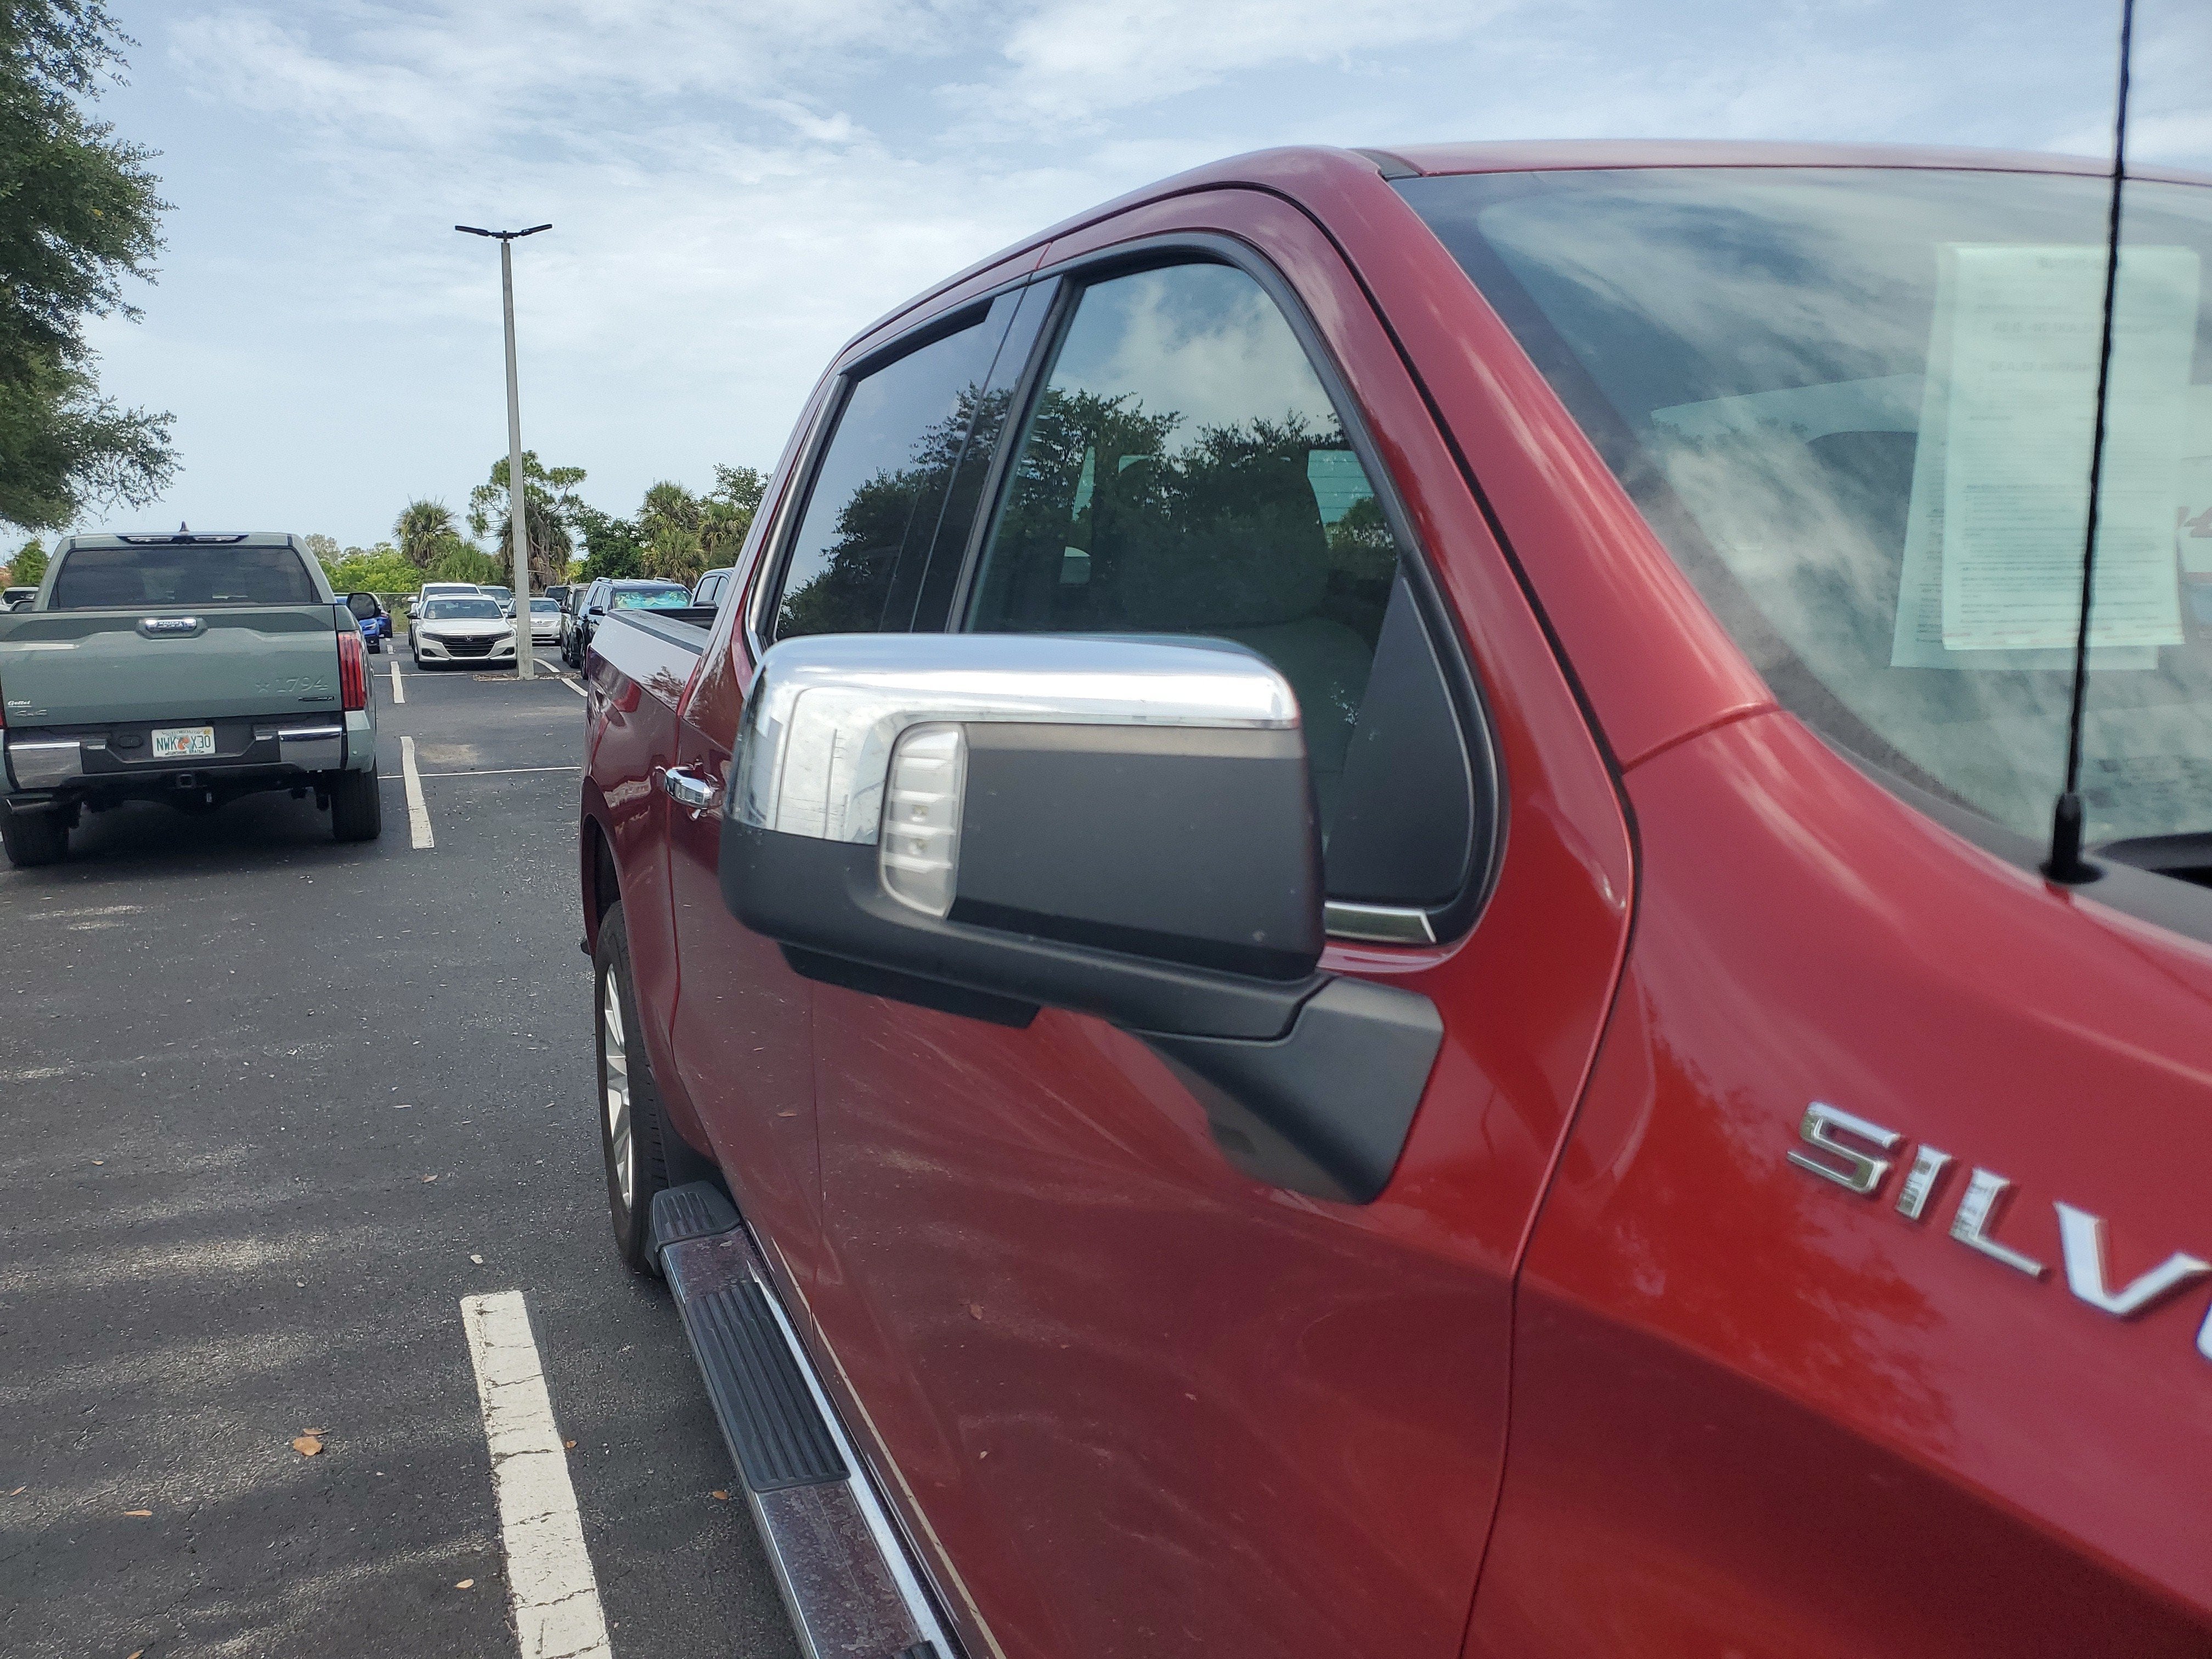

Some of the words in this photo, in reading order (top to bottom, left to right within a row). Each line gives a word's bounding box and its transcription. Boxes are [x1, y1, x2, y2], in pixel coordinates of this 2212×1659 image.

[275, 675, 328, 692] 1794
[156, 736, 177, 752] NWK
[1787, 1101, 2212, 1364] SILV
